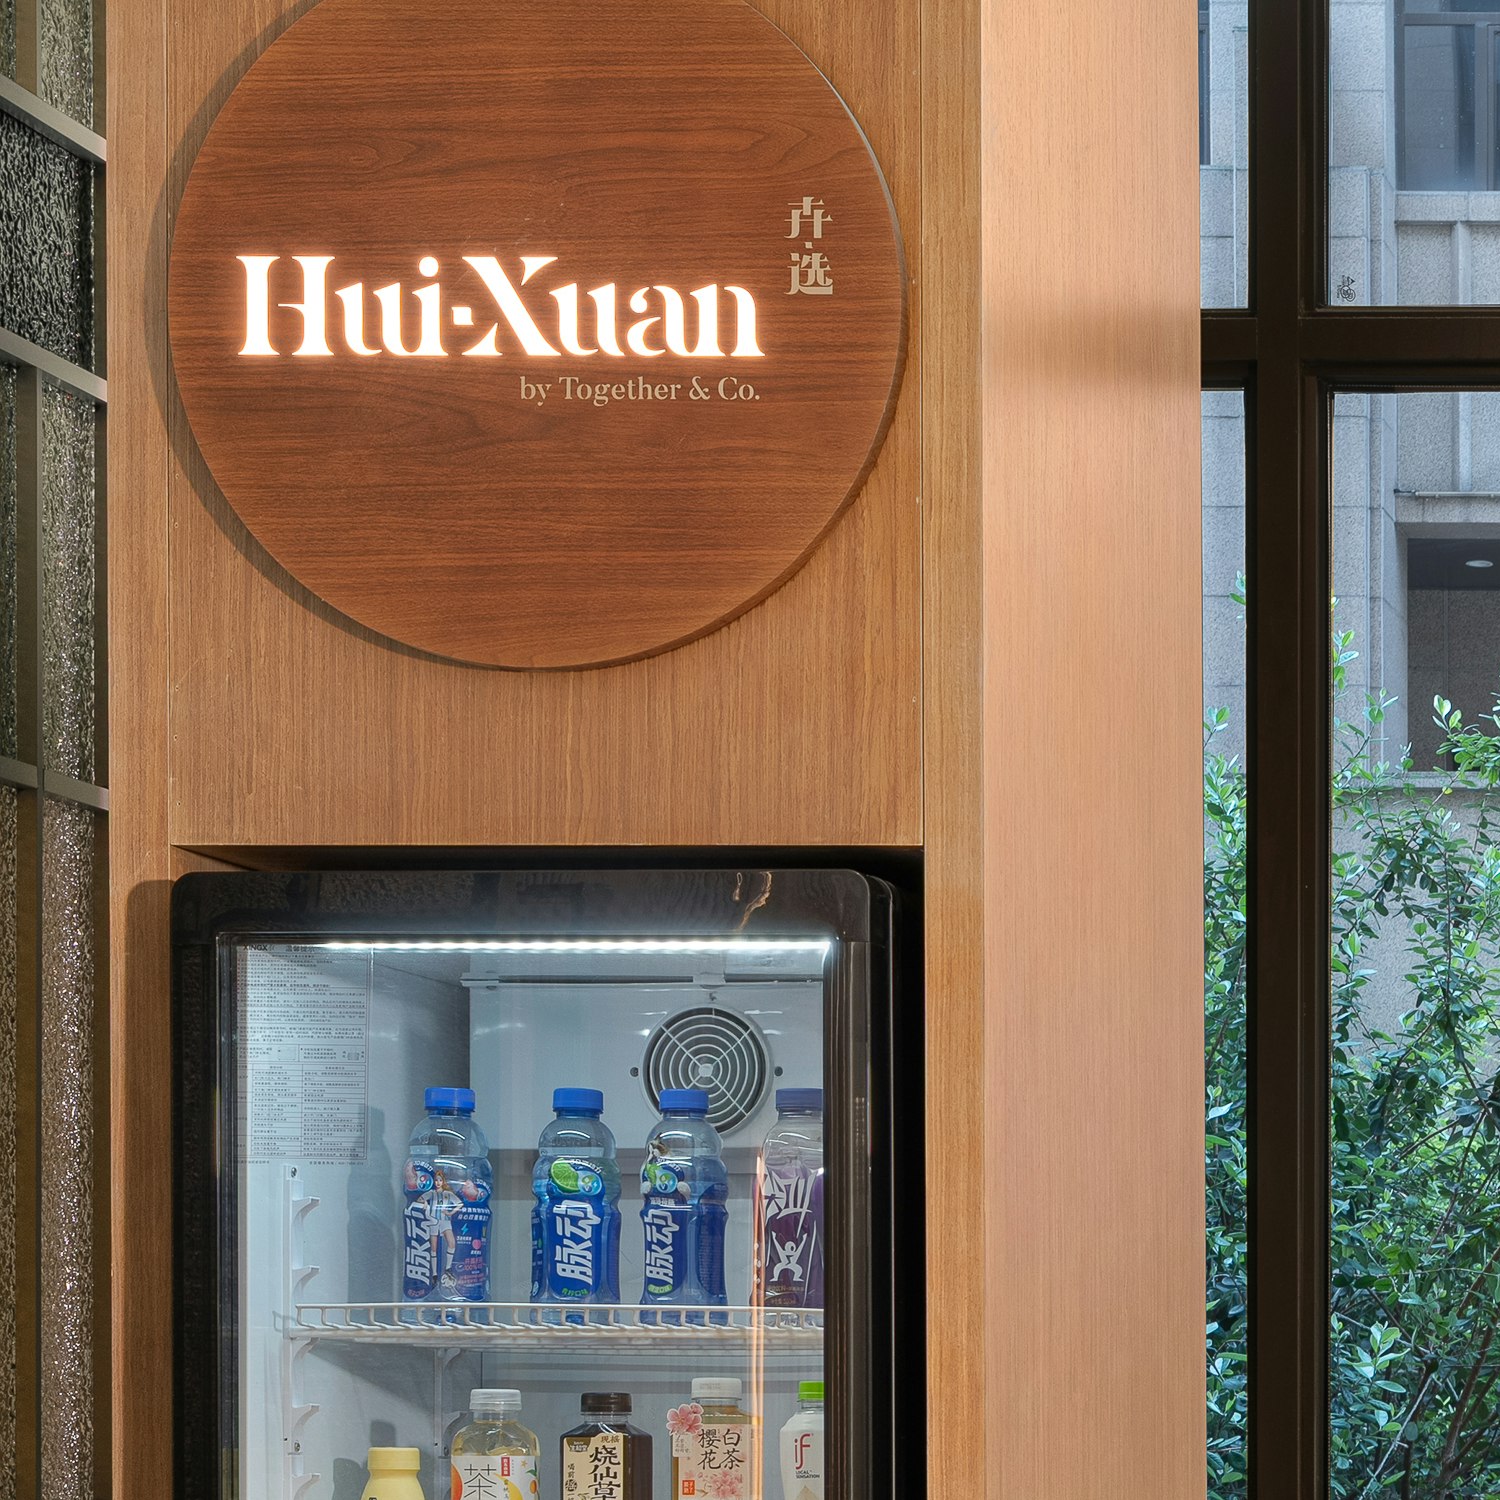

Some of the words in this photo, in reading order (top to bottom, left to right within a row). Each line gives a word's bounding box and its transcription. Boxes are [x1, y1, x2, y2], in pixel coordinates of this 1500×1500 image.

[520, 376, 552, 407] by
[559, 376, 681, 407] Together
[689, 376, 711, 400] &
[718, 376, 760, 400] Co.
[553, 1200, 602, 1285] 脉动
[644, 1208, 680, 1284] 脉动
[721, 1428, 745, 1470] 白茶
[794, 1433, 811, 1470] if
